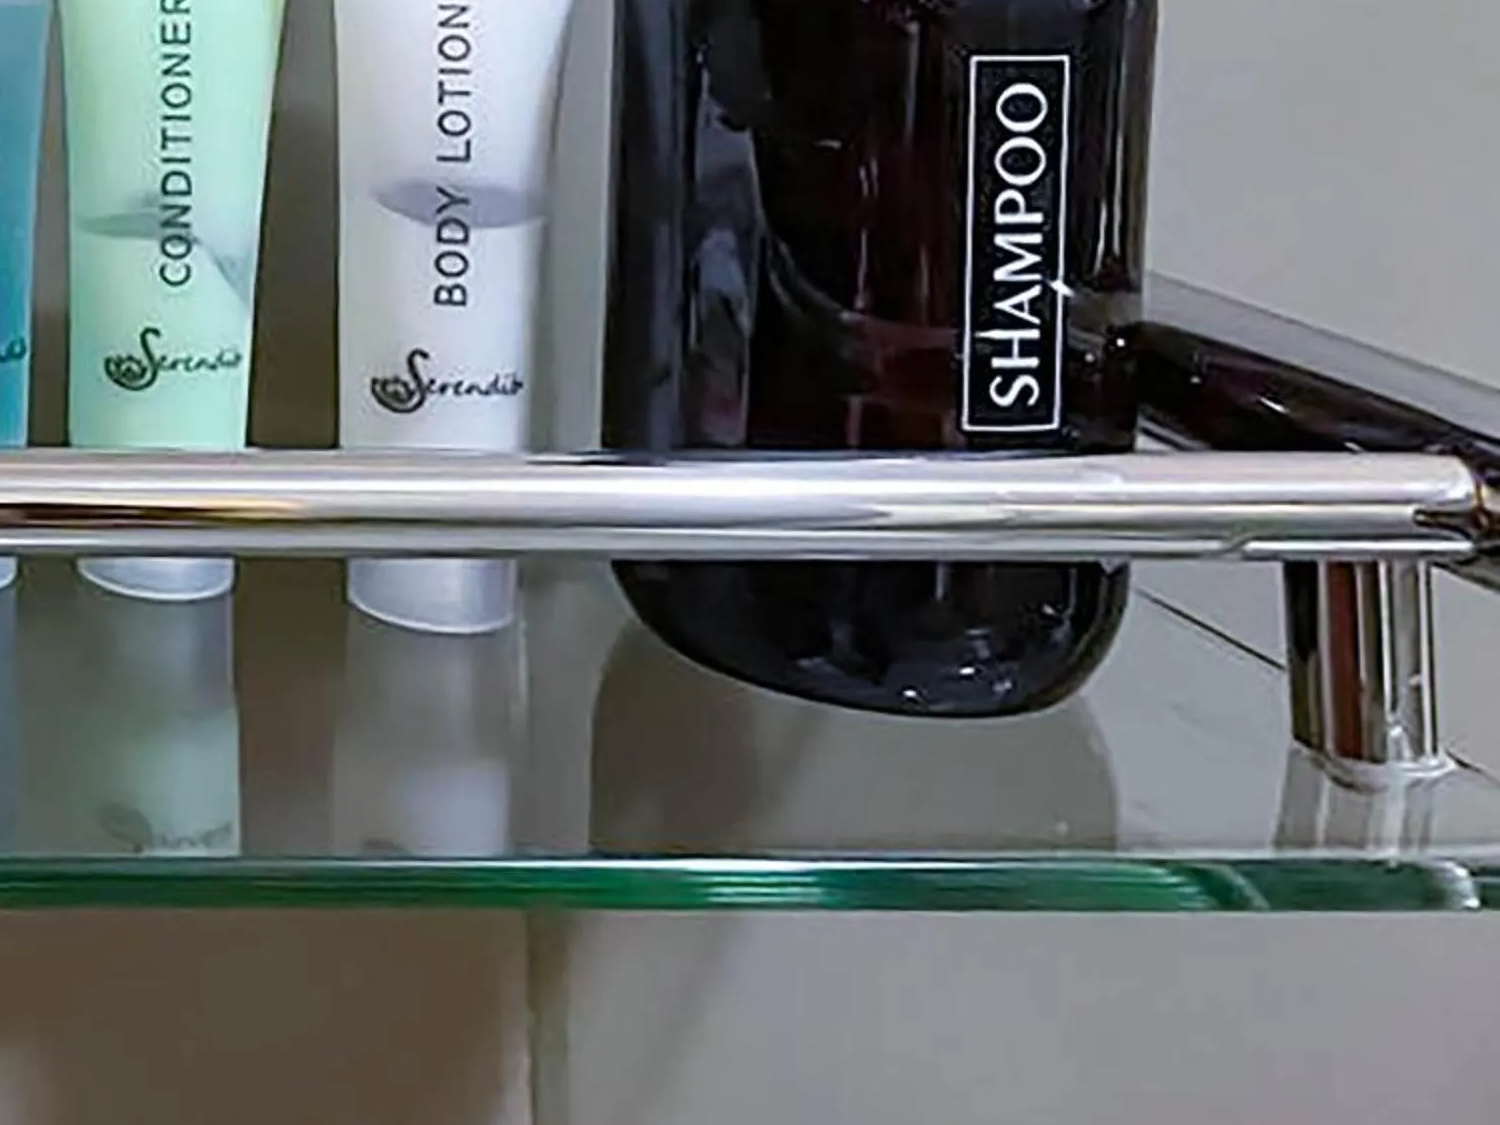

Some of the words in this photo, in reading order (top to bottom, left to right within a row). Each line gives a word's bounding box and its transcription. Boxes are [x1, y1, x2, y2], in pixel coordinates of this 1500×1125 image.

[436, 3, 473, 163] LOTION
[434, 187, 471, 307] BODY
[988, 82, 1047, 407] SHAMPOO
